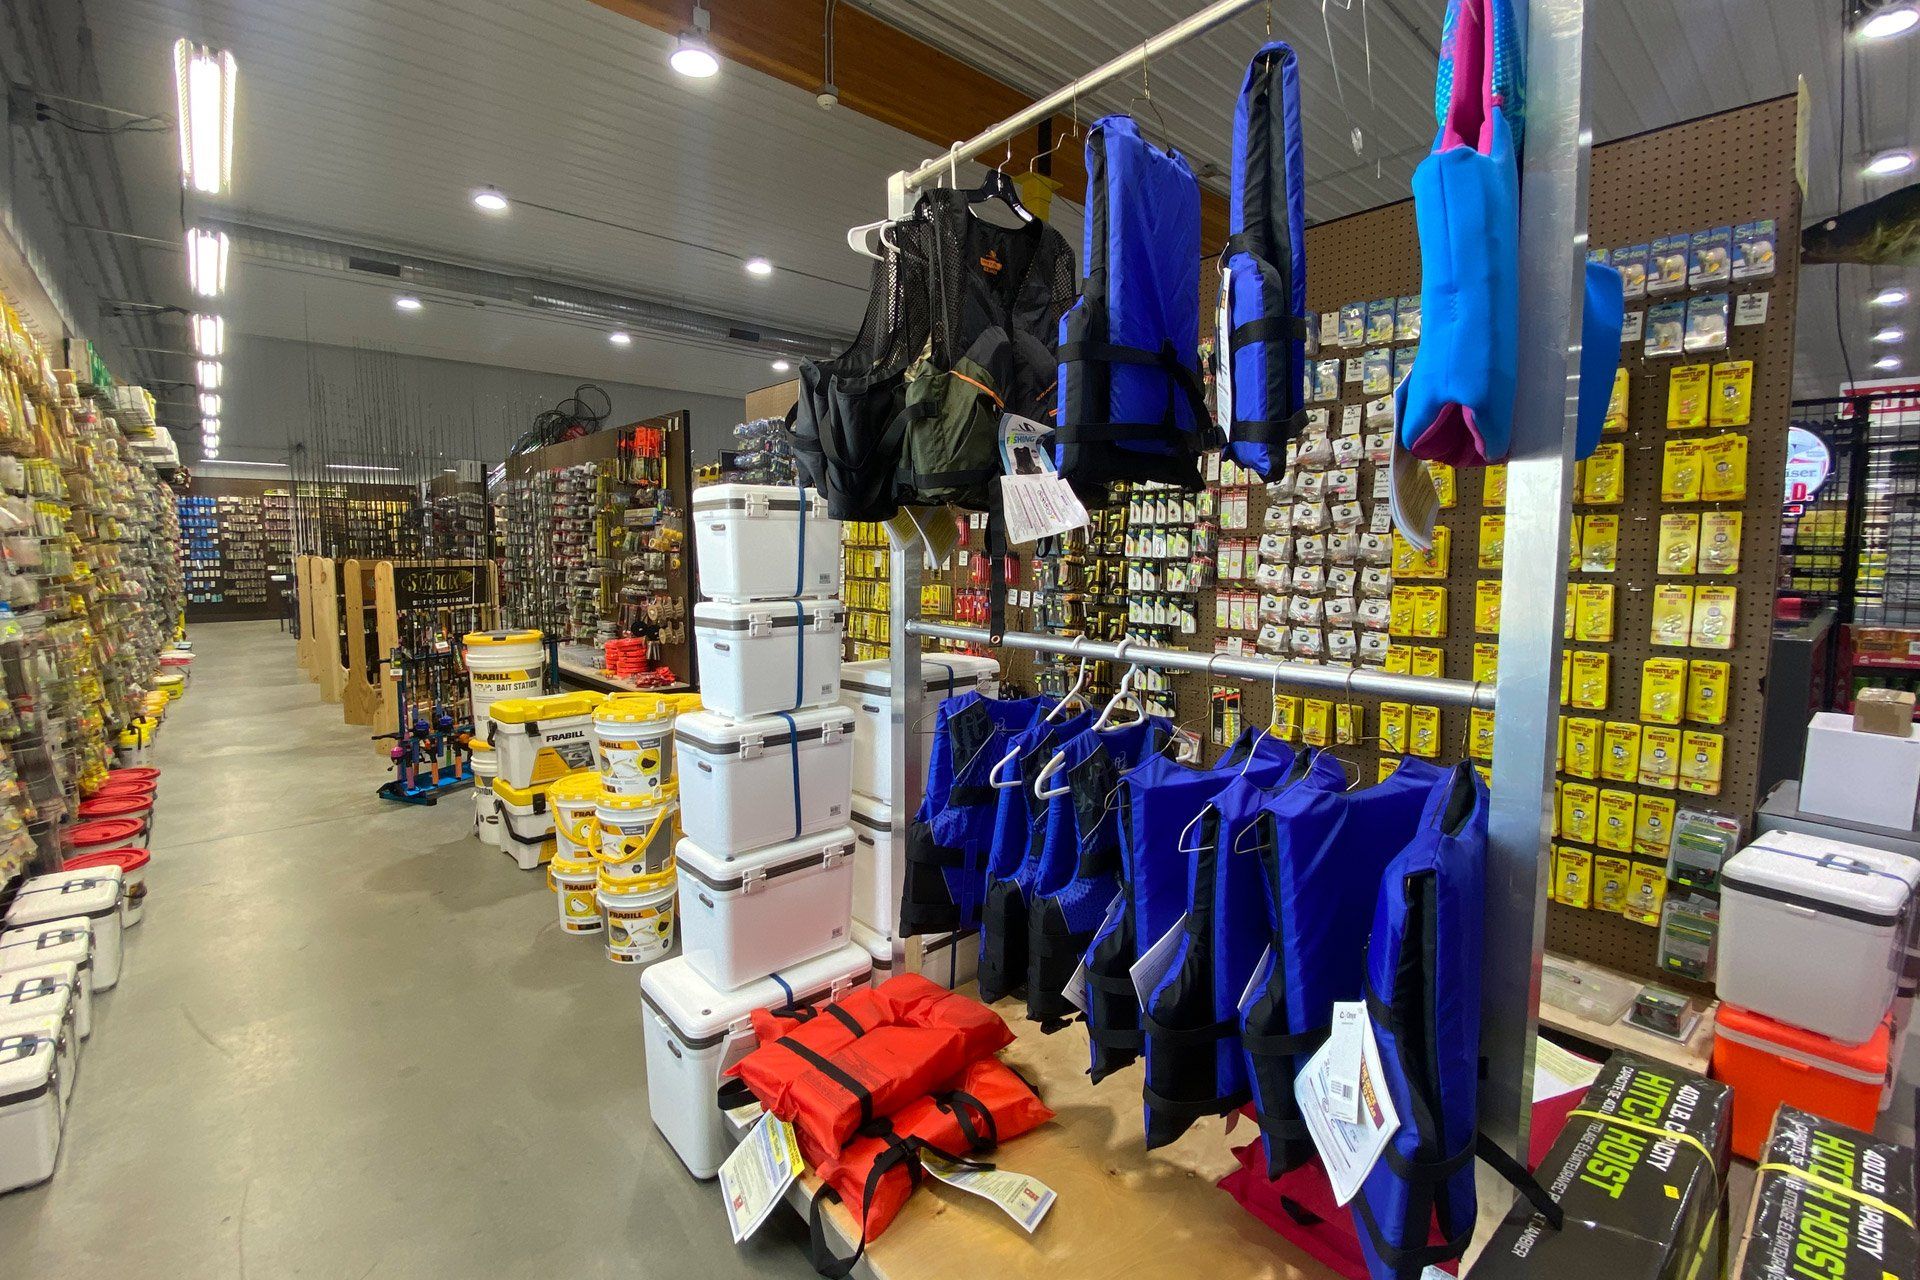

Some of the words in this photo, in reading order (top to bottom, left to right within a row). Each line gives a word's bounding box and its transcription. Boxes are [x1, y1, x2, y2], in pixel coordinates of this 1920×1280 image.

[497, 683, 512, 692] BAIT
[513, 681, 537, 690] STATION
[546, 731, 584, 742] FRABILL
[609, 911, 643, 919] FRABILL
[1676, 1084, 1700, 1107] 400
[1579, 1127, 1648, 1200] HOIST
[1863, 1149, 1886, 1174] 400
[1511, 1224, 1541, 1258] JAMBIER
